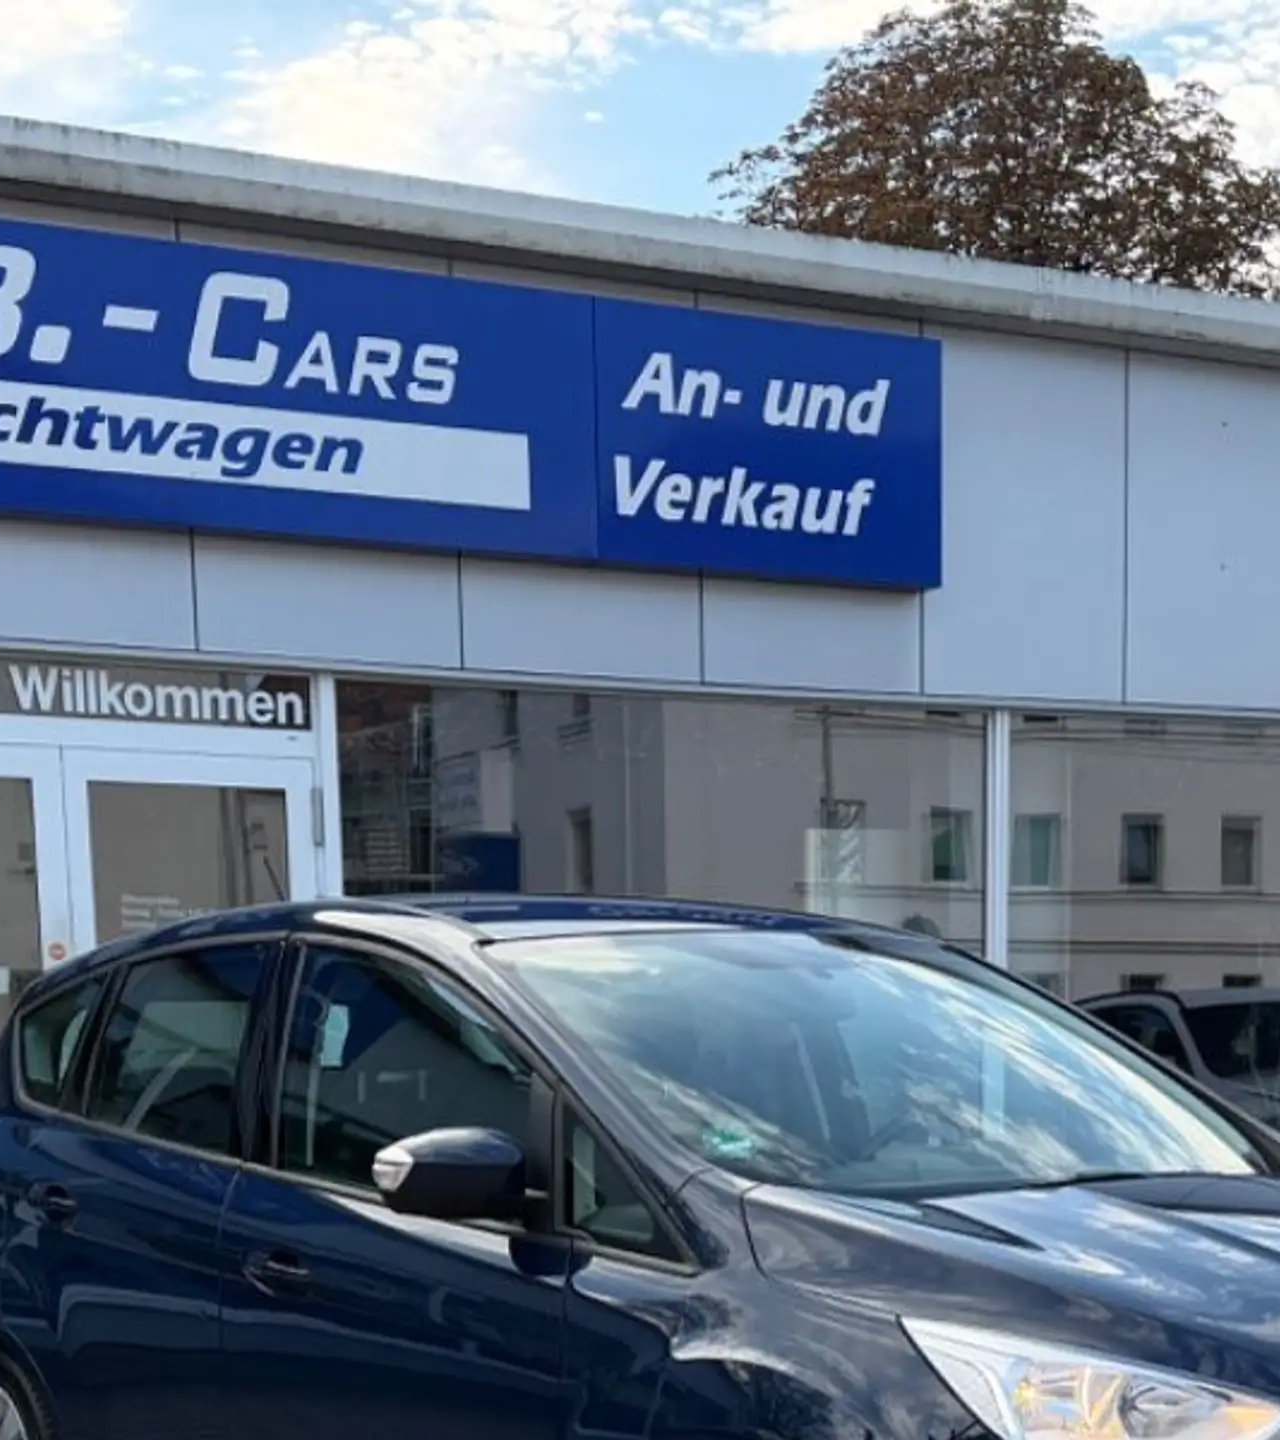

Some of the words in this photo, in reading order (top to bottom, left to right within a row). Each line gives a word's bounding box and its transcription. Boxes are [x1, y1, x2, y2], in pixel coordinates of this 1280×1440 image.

[620, 351, 743, 419] An-
[762, 378, 891, 437] und
[612, 453, 875, 537] Verkauf
[8, 662, 306, 728] Willkommen
